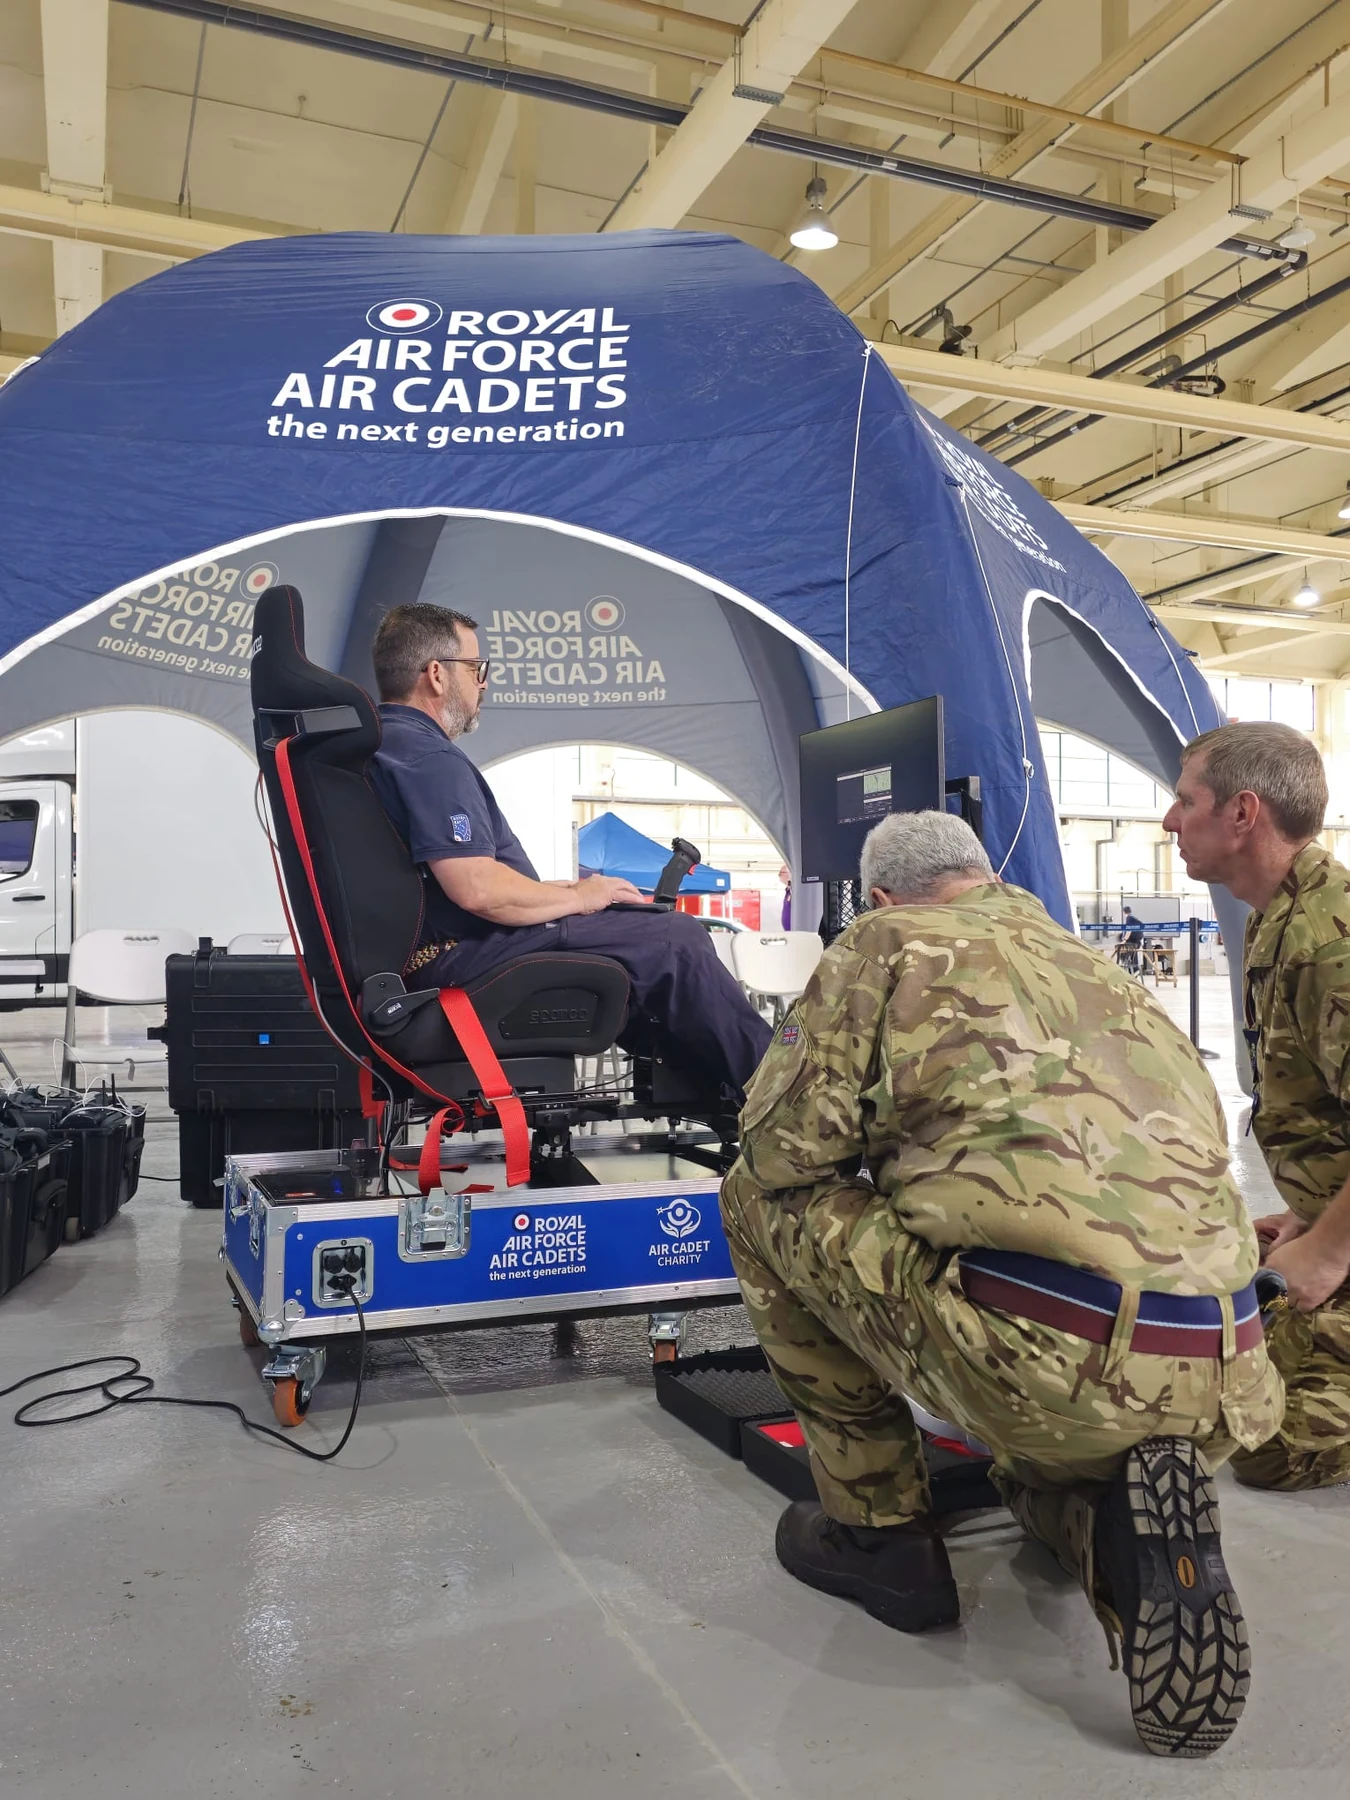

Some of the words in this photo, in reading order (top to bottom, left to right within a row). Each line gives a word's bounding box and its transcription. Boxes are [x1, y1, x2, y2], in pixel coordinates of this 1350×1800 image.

[447, 307, 631, 336] ROYAL
[322, 338, 432, 371] AIR
[442, 336, 630, 373] FORCE
[271, 372, 377, 412] AIR
[392, 373, 628, 414] CADETS
[266, 413, 327, 441] the
[336, 421, 418, 443] next
[426, 417, 625, 449] generation
[534, 1214, 586, 1232] ROYAL
[502, 1234, 532, 1251] AIR
[534, 1230, 586, 1249] FORCE
[648, 1243, 669, 1256] AIR
[671, 1240, 711, 1255] CADET
[489, 1253, 518, 1270] AIR
[521, 1247, 587, 1266] CADETS
[657, 1254, 702, 1267] CHARITY
[489, 1271, 506, 1281] the
[508, 1269, 531, 1280] next
[533, 1264, 586, 1279] generation
